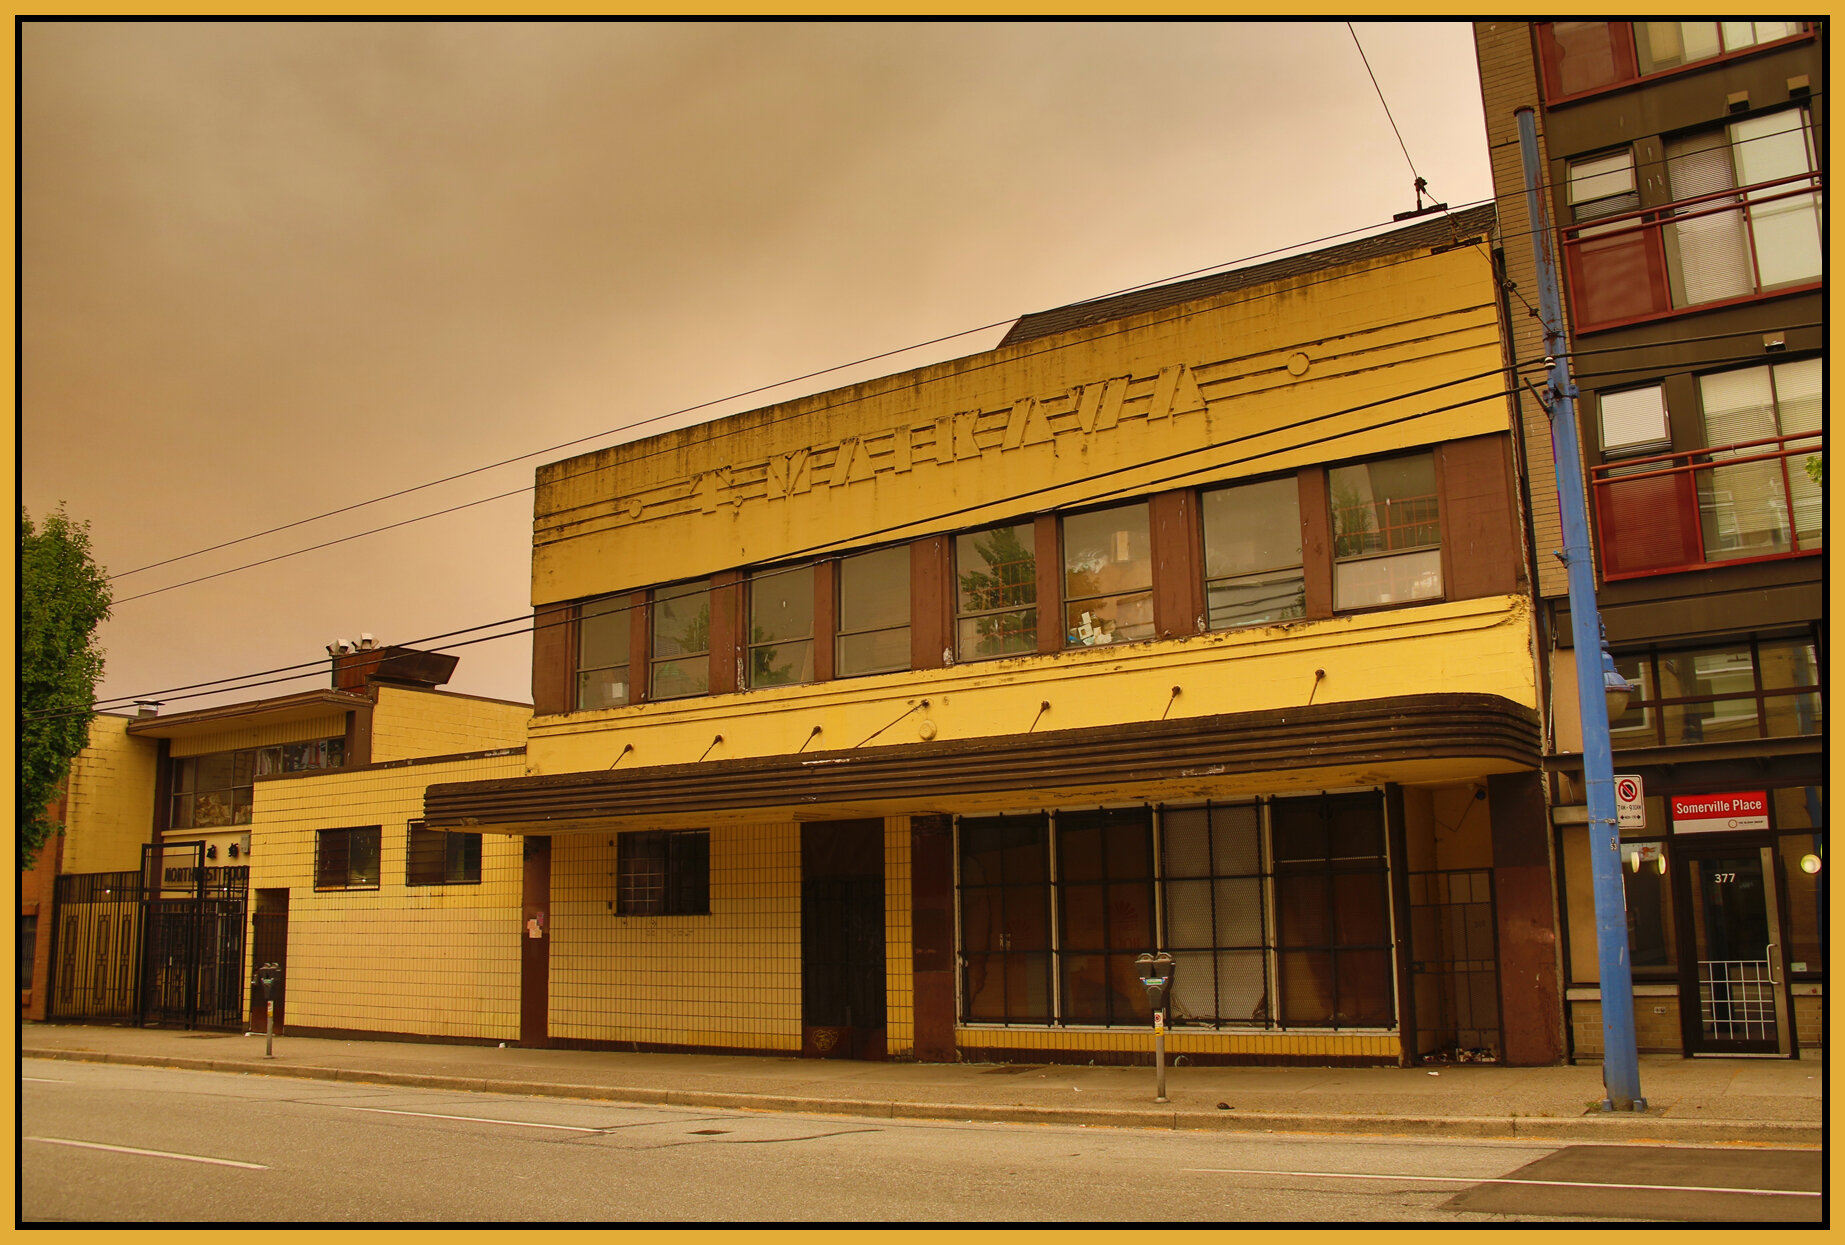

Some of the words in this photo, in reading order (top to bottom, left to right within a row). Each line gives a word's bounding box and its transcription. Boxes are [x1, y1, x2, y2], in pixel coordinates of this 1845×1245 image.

[767, 362, 1209, 502] MAIKAWA
[1676, 801, 1730, 815] Somerville
[1732, 799, 1762, 812] Place
[164, 867, 218, 882] NORTHST
[1714, 873, 1736, 884] 377
